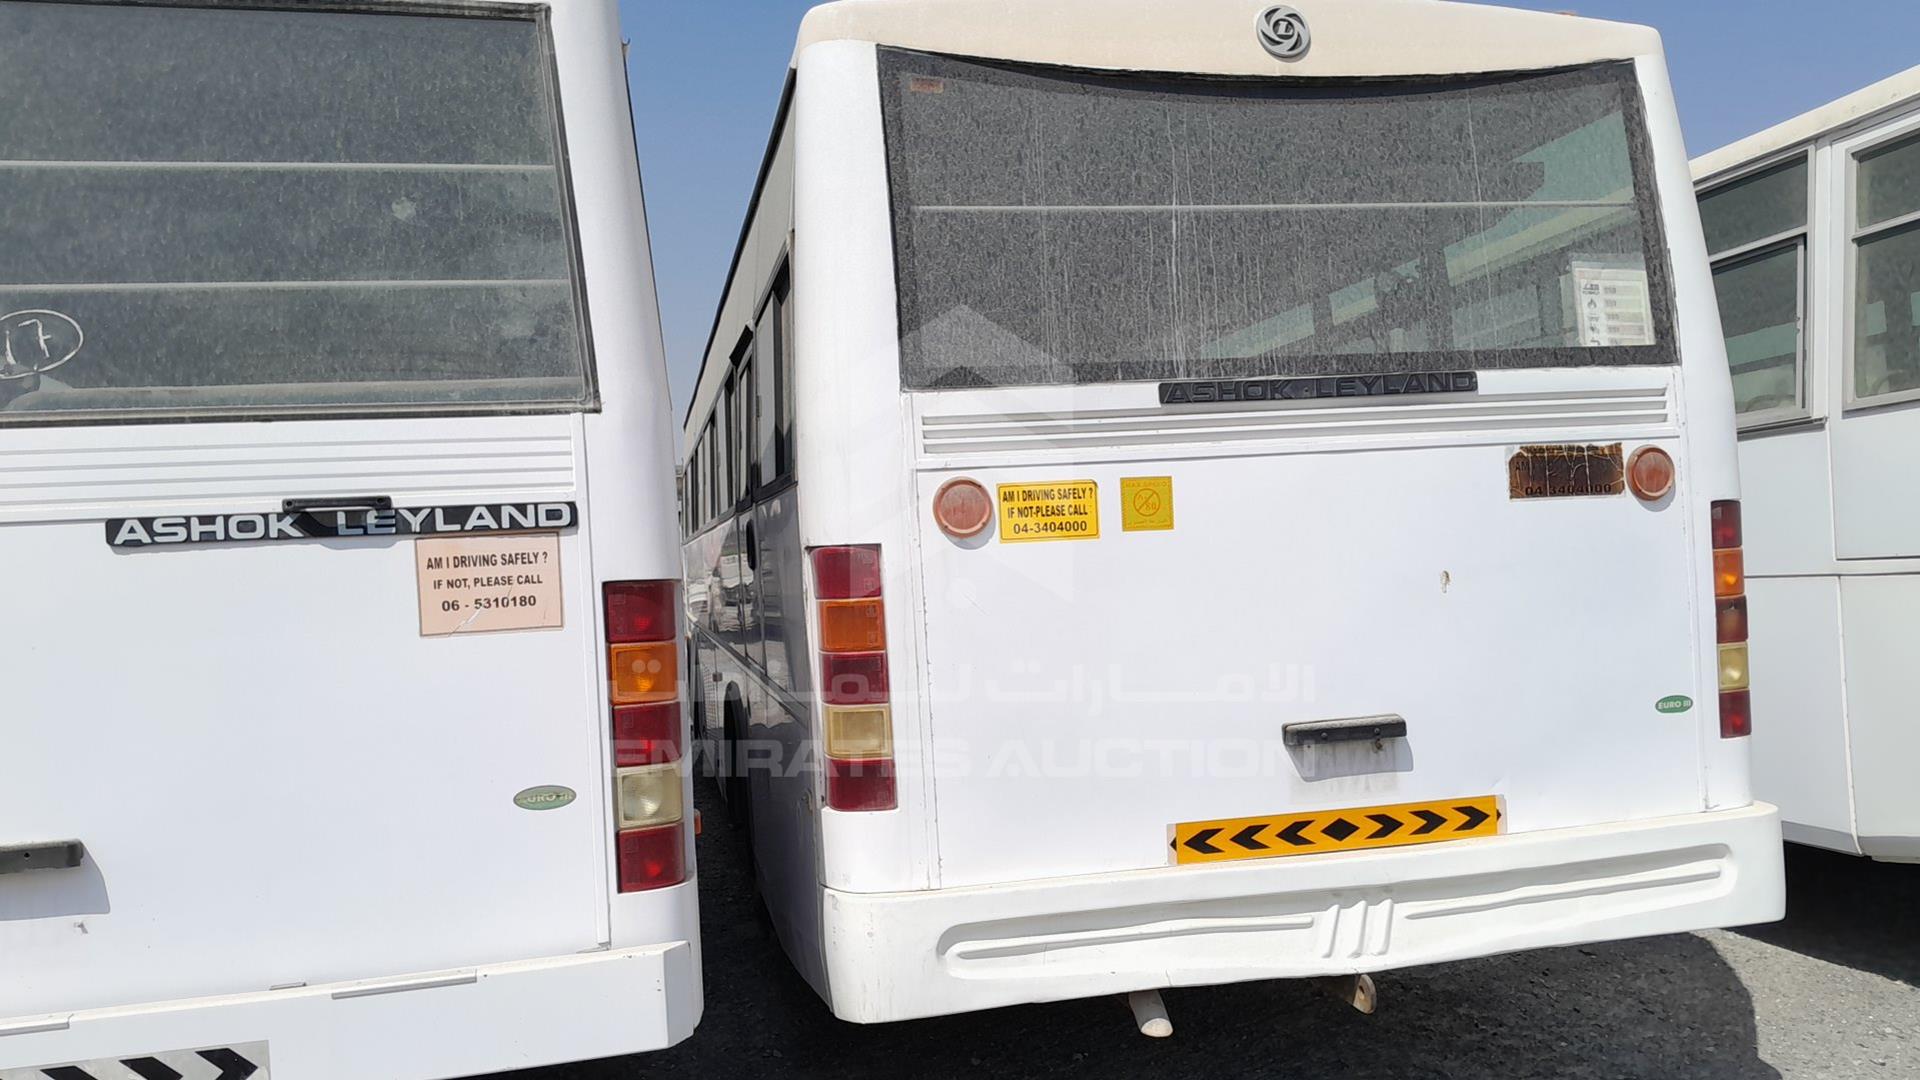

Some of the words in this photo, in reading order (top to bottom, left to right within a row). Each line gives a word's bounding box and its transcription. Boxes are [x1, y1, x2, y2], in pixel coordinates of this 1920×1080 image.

[1164, 380, 1294, 402] ASHOK
[1315, 373, 1475, 396] LEYLAND
[1002, 491, 1015, 502] AM
[1022, 488, 1055, 502] DRIVING
[1057, 487, 1087, 500] SAFELY
[1089, 487, 1093, 498] ?
[1007, 507, 1015, 518] IF
[1068, 504, 1088, 516] CALL
[114, 513, 304, 545] ASHOK
[337, 502, 572, 536] LEYLAND
[1014, 520, 1087, 534] 04-3404000
[427, 557, 443, 570] AM
[453, 553, 498, 568] DRIVING
[500, 551, 540, 566] SAFELY
[542, 551, 548, 564] ?
[433, 580, 443, 589] IF
[447, 578, 471, 590] NOT,
[474, 575, 513, 587] PLEASE
[517, 574, 543, 584] CALL
[442, 600, 460, 611] 06
[474, 595, 536, 610] 5310180
[1658, 701, 1682, 710] EURO
[516, 793, 556, 803] URO
